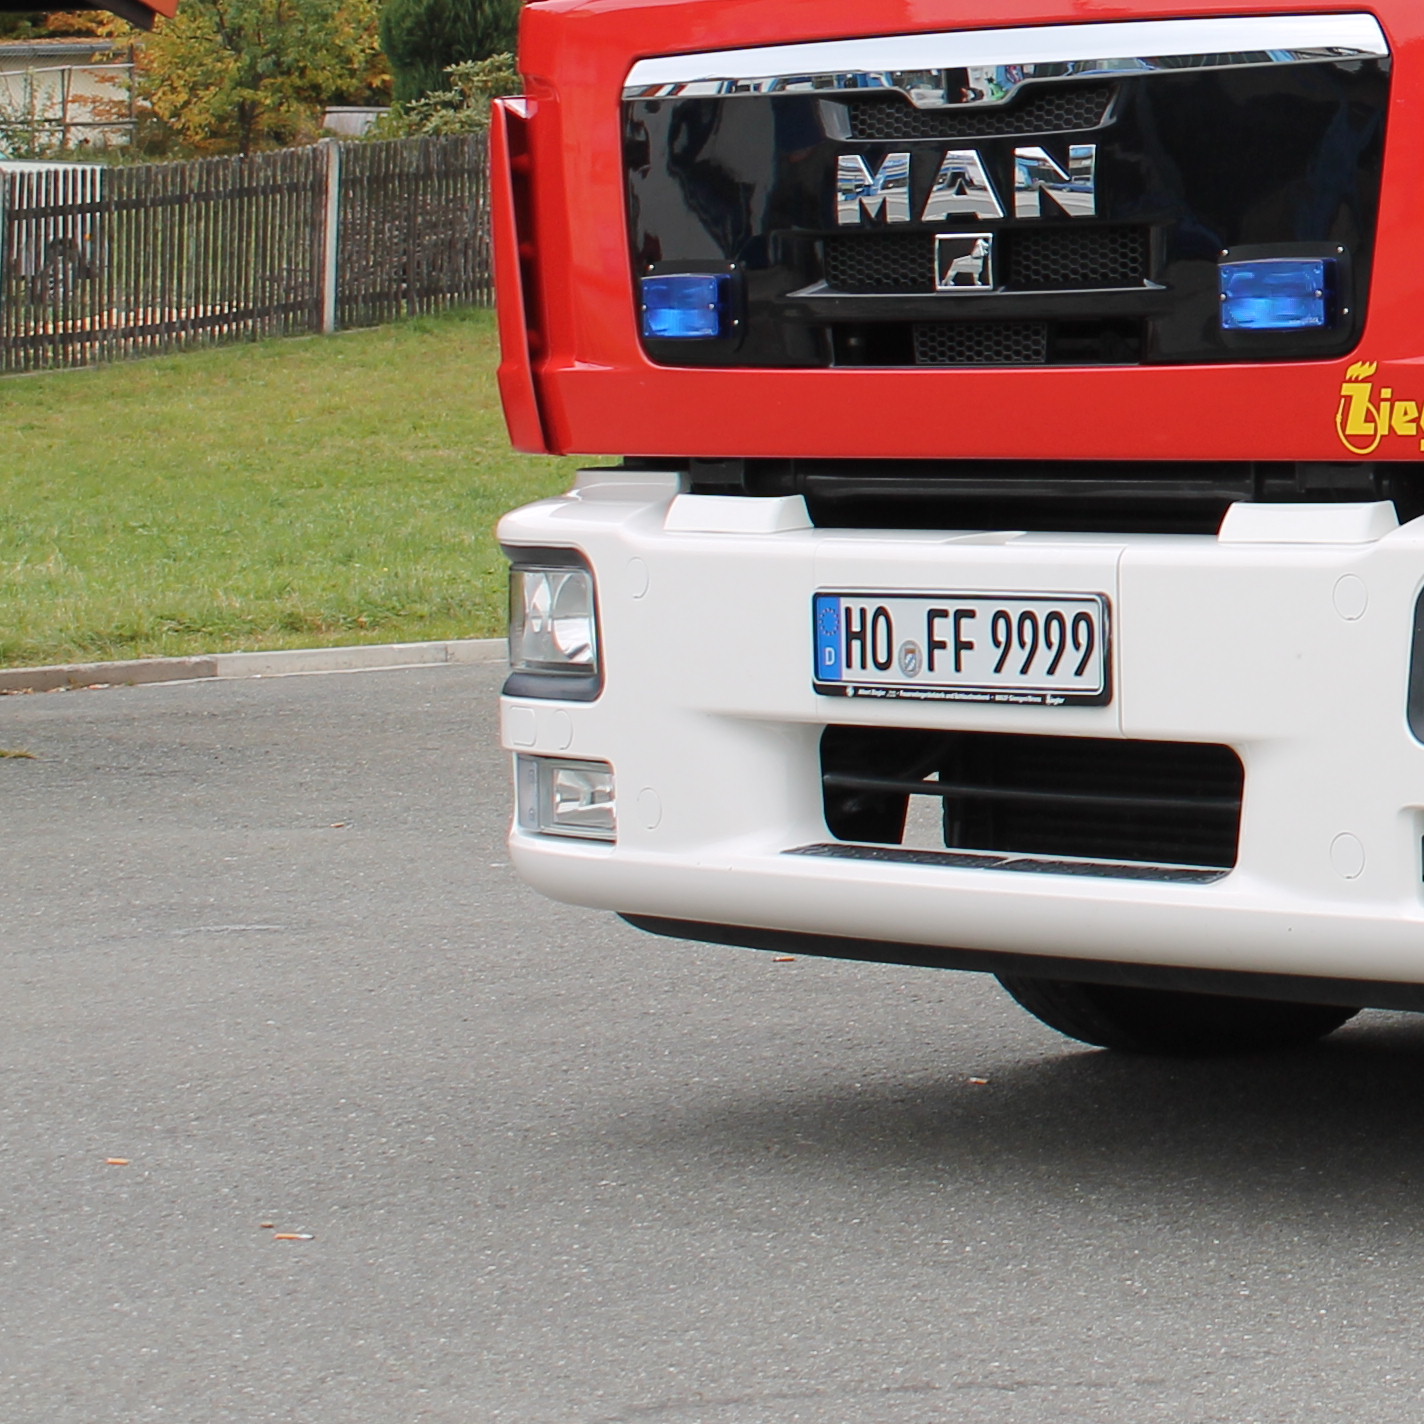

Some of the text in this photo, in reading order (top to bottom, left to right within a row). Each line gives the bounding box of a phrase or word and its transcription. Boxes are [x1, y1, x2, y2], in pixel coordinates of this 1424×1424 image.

[836, 143, 1098, 228] MAN
[823, 647, 835, 666] D
[844, 604, 1096, 677] HO FF 9999
